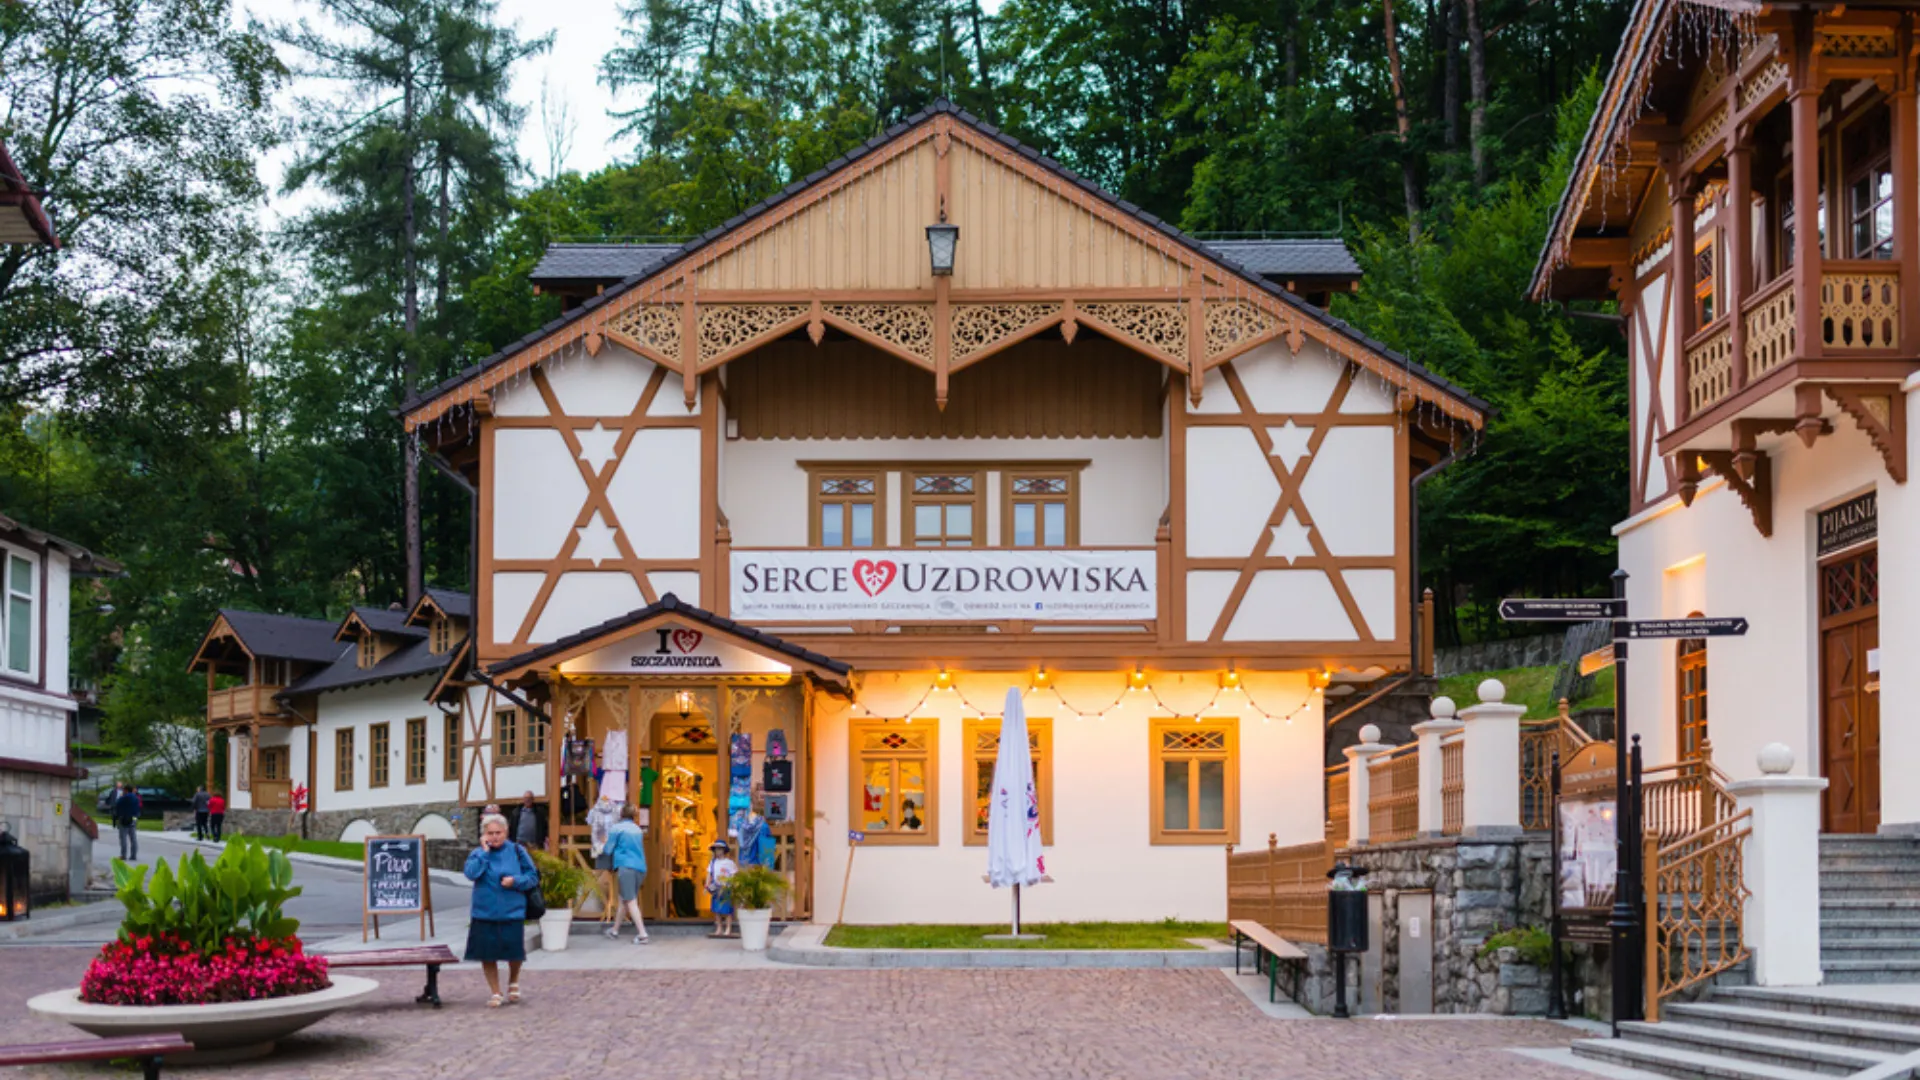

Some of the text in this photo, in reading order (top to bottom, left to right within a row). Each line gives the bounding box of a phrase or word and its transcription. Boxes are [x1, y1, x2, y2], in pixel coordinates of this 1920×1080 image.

[742, 563, 1149, 594] SERCE UZDROWISKA
[655, 629, 671, 654] I
[631, 656, 721, 668] SZCZAWNICA
[372, 851, 412, 873] Piwo
